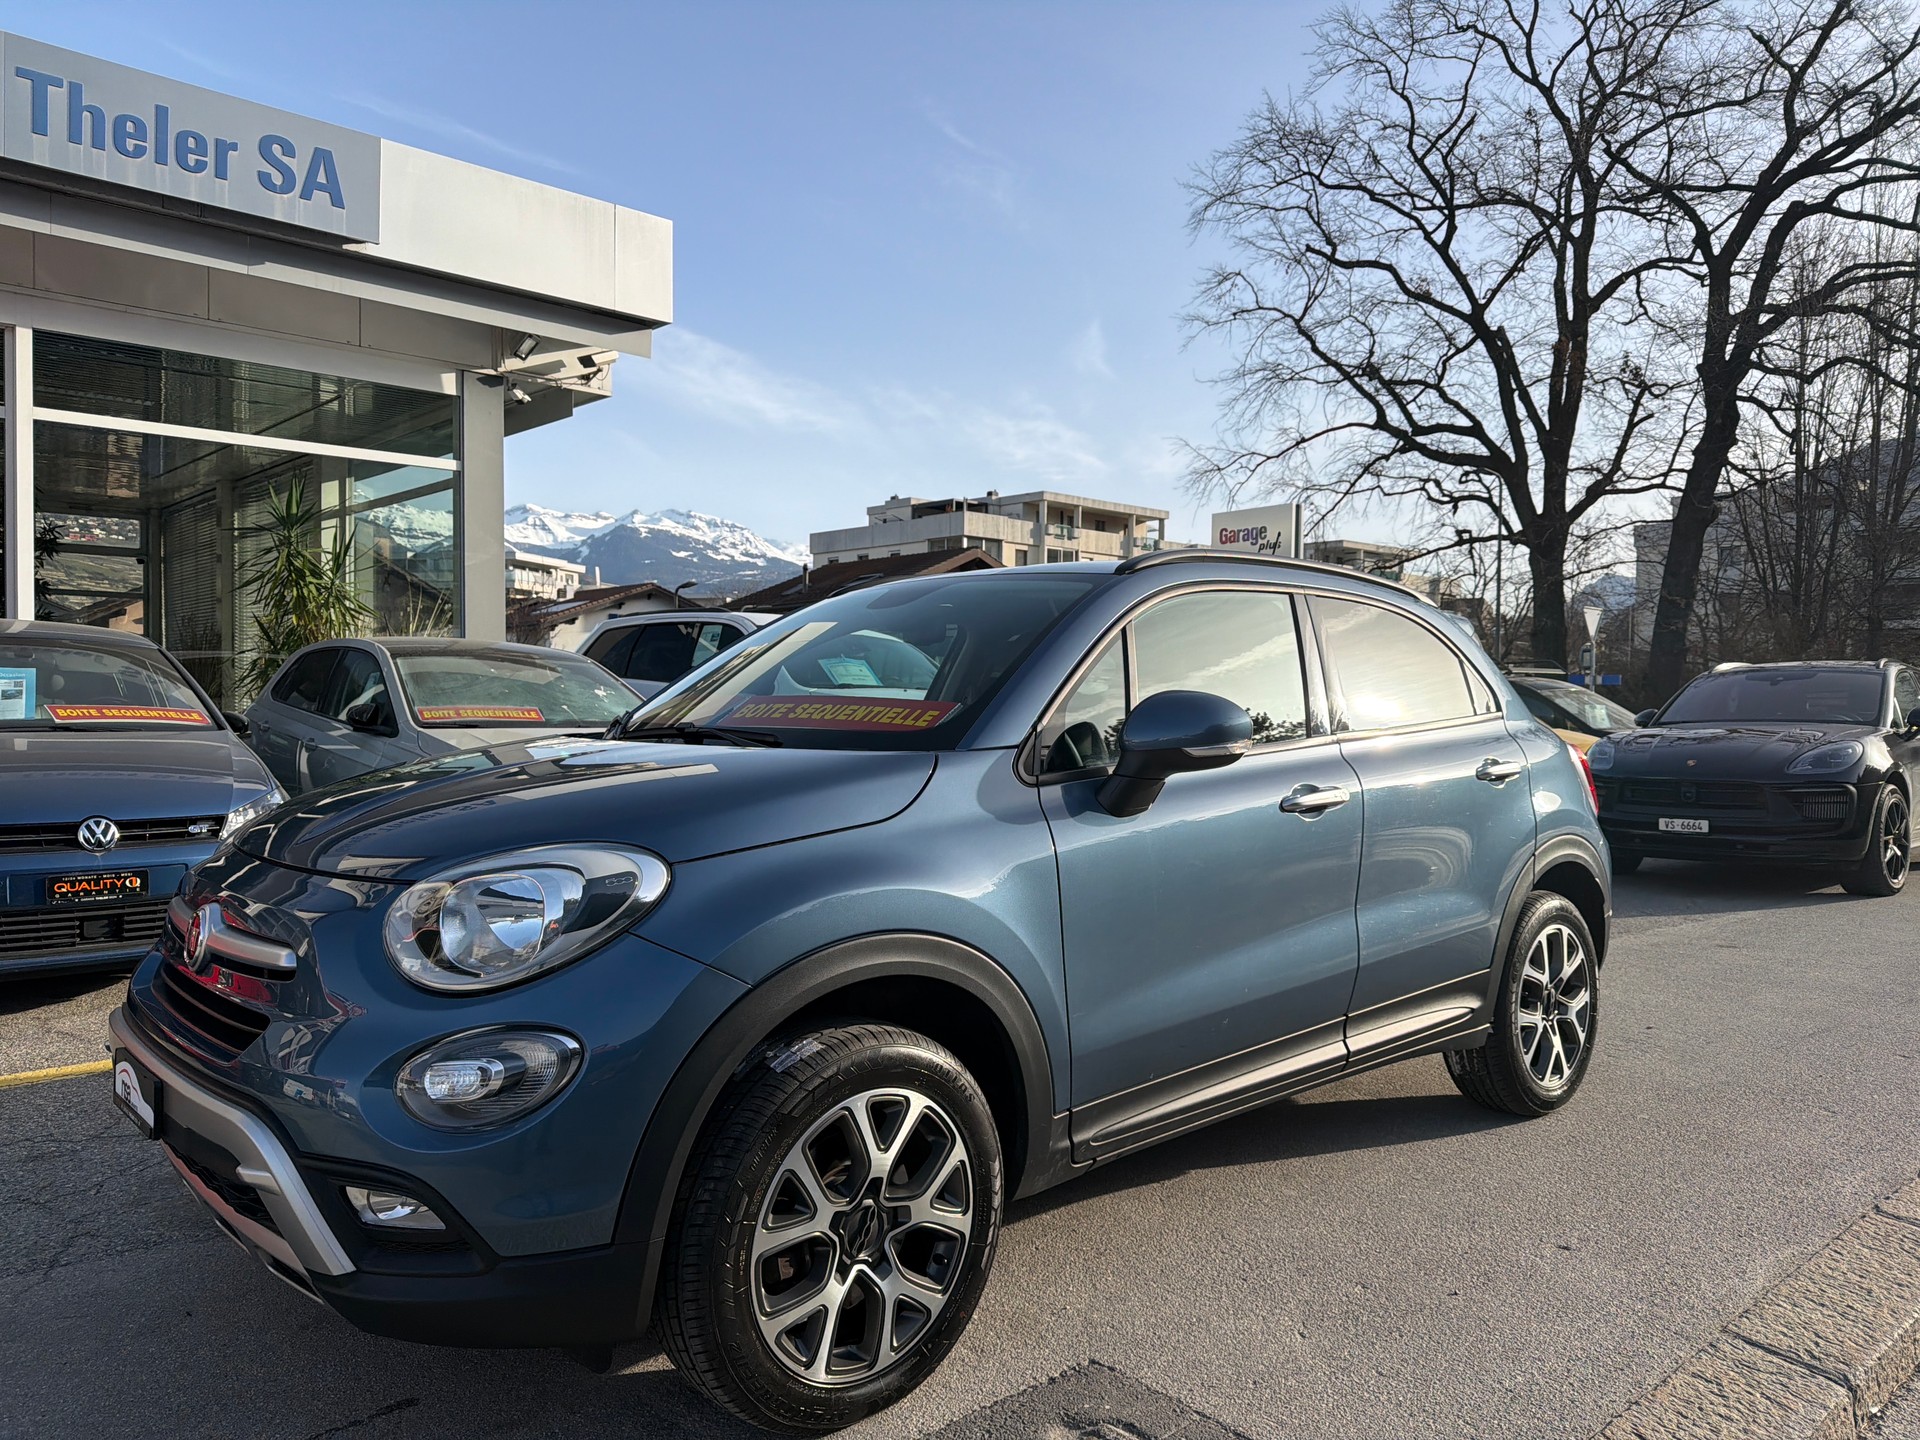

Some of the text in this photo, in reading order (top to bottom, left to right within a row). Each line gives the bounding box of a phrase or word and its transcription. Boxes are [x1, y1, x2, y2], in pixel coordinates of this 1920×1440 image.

[15, 66, 345, 209] Theler SA
[1219, 526, 1267, 546] Garage
[56, 708, 202, 720] BOITE SEQUENTIELLE
[423, 710, 539, 718] BOITE SEQUENTIELLE
[733, 703, 940, 727] BOITE SEQUENTIELLE
[54, 879, 124, 892] QUALITY
